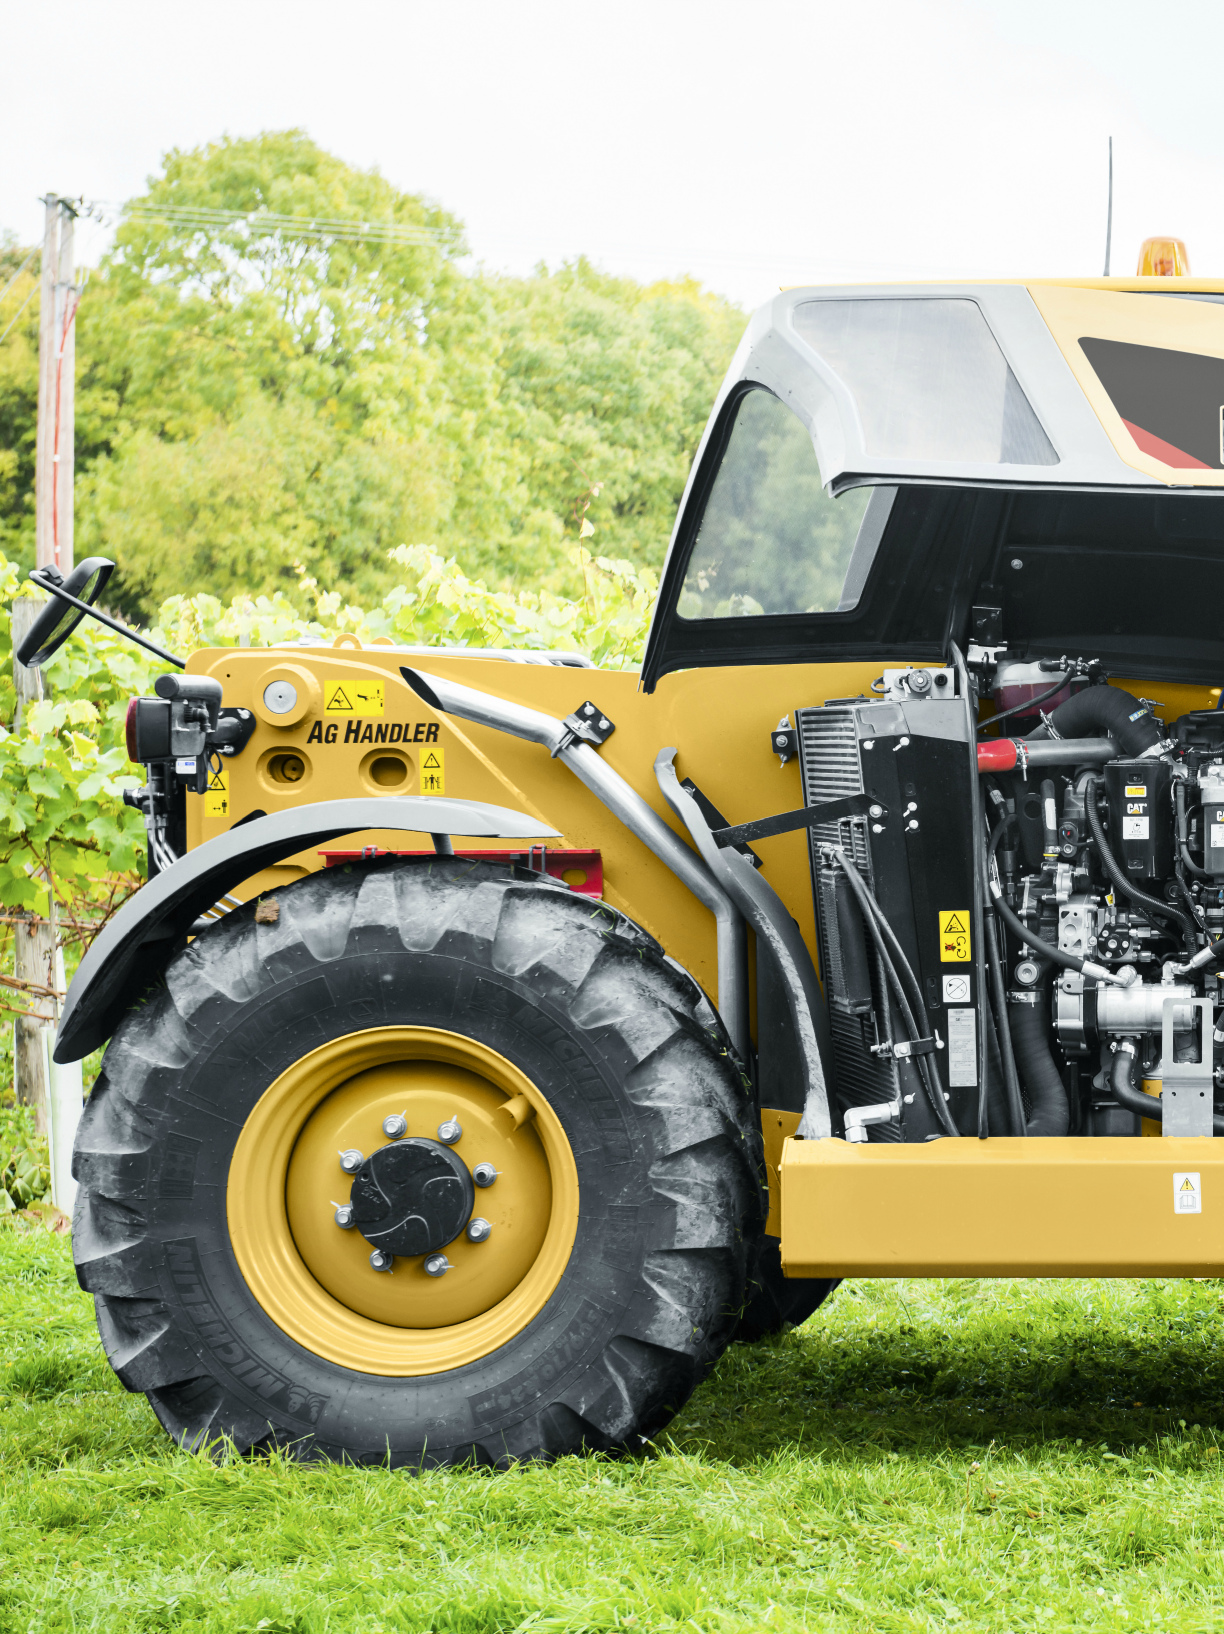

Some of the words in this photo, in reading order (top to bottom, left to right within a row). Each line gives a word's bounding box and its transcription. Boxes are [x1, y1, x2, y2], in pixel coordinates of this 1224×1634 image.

[344, 720, 440, 744] HANDLER
[1127, 803, 1144, 814] CAT
[164, 1238, 286, 1404] MICHELIN
